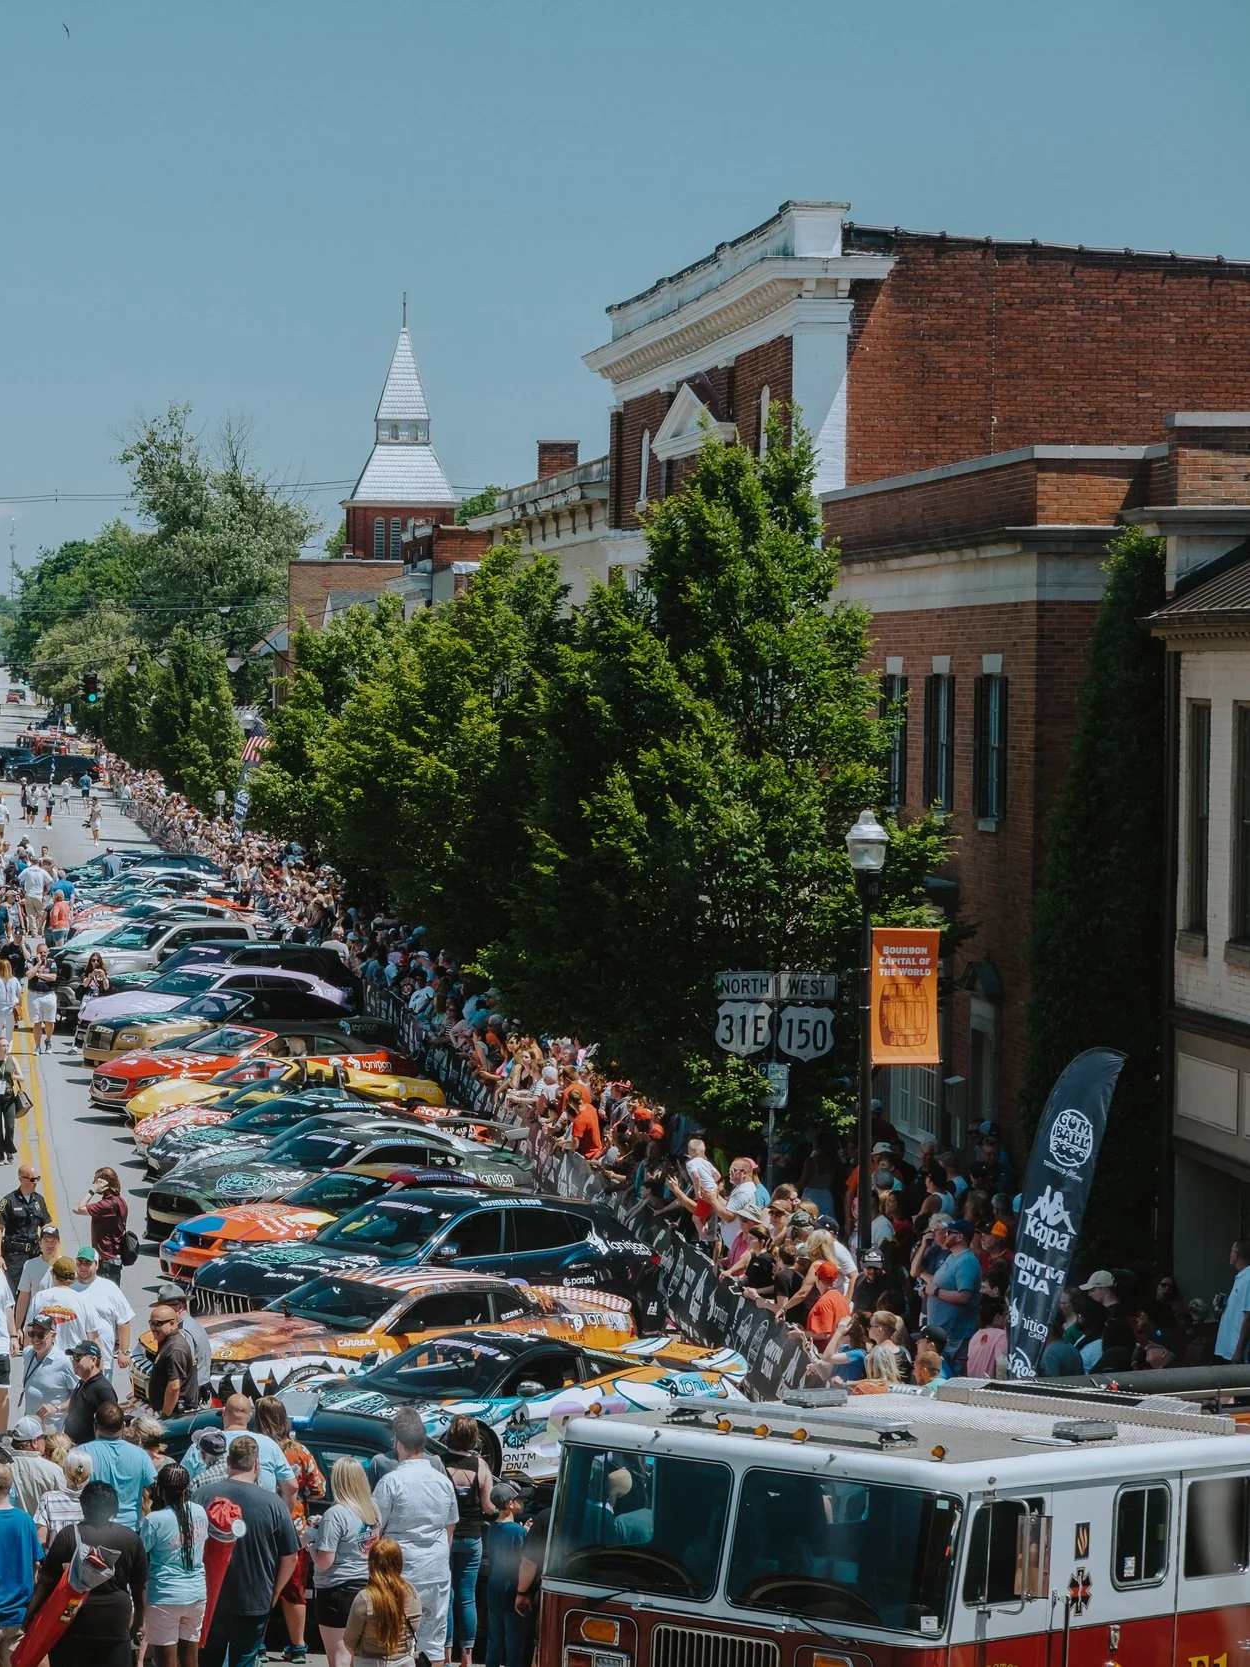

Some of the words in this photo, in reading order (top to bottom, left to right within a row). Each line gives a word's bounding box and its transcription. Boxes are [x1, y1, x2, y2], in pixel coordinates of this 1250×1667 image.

[882, 945, 928, 955] BOURBON
[878, 956, 917, 965] CAPITAL
[919, 957, 931, 965] OF
[878, 968, 897, 976] THE
[899, 967, 932, 976] WORLD
[720, 978, 769, 994] NORTH
[788, 979, 826, 995] WEST
[721, 1014, 765, 1046] 31E
[786, 1019, 827, 1051] 150
[361, 1059, 392, 1071] Ignition
[478, 1172, 515, 1185] Ignition
[479, 1198, 520, 1207] GUMBALL
[519, 1198, 542, 1206] 3000
[1024, 1214, 1070, 1252] Kappa
[606, 1239, 649, 1253] Ignition
[570, 1275, 595, 1286] parsiq
[337, 1338, 377, 1348] CARRERA
[502, 1452, 537, 1463] QNTM
[505, 1461, 530, 1470] DNA
